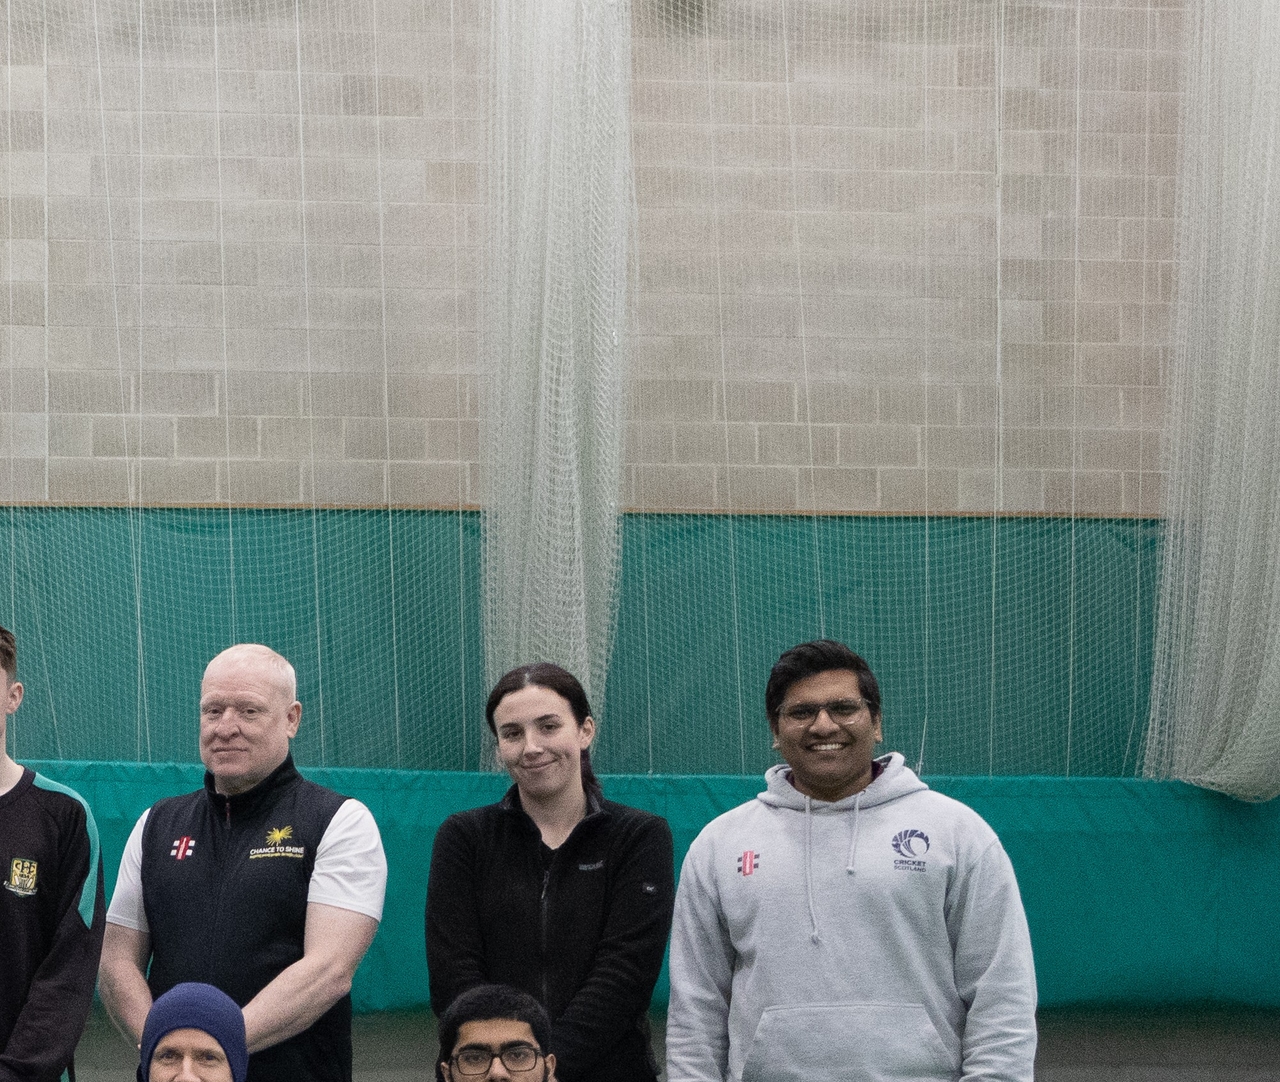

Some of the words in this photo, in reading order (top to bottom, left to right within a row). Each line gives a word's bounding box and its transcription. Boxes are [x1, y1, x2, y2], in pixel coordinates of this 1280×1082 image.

[250, 847, 275, 855] CHANCE
[285, 846, 305, 854] SHINE
[893, 859, 927, 867] CRICKET
[893, 865, 927, 873] SCOTLAND
